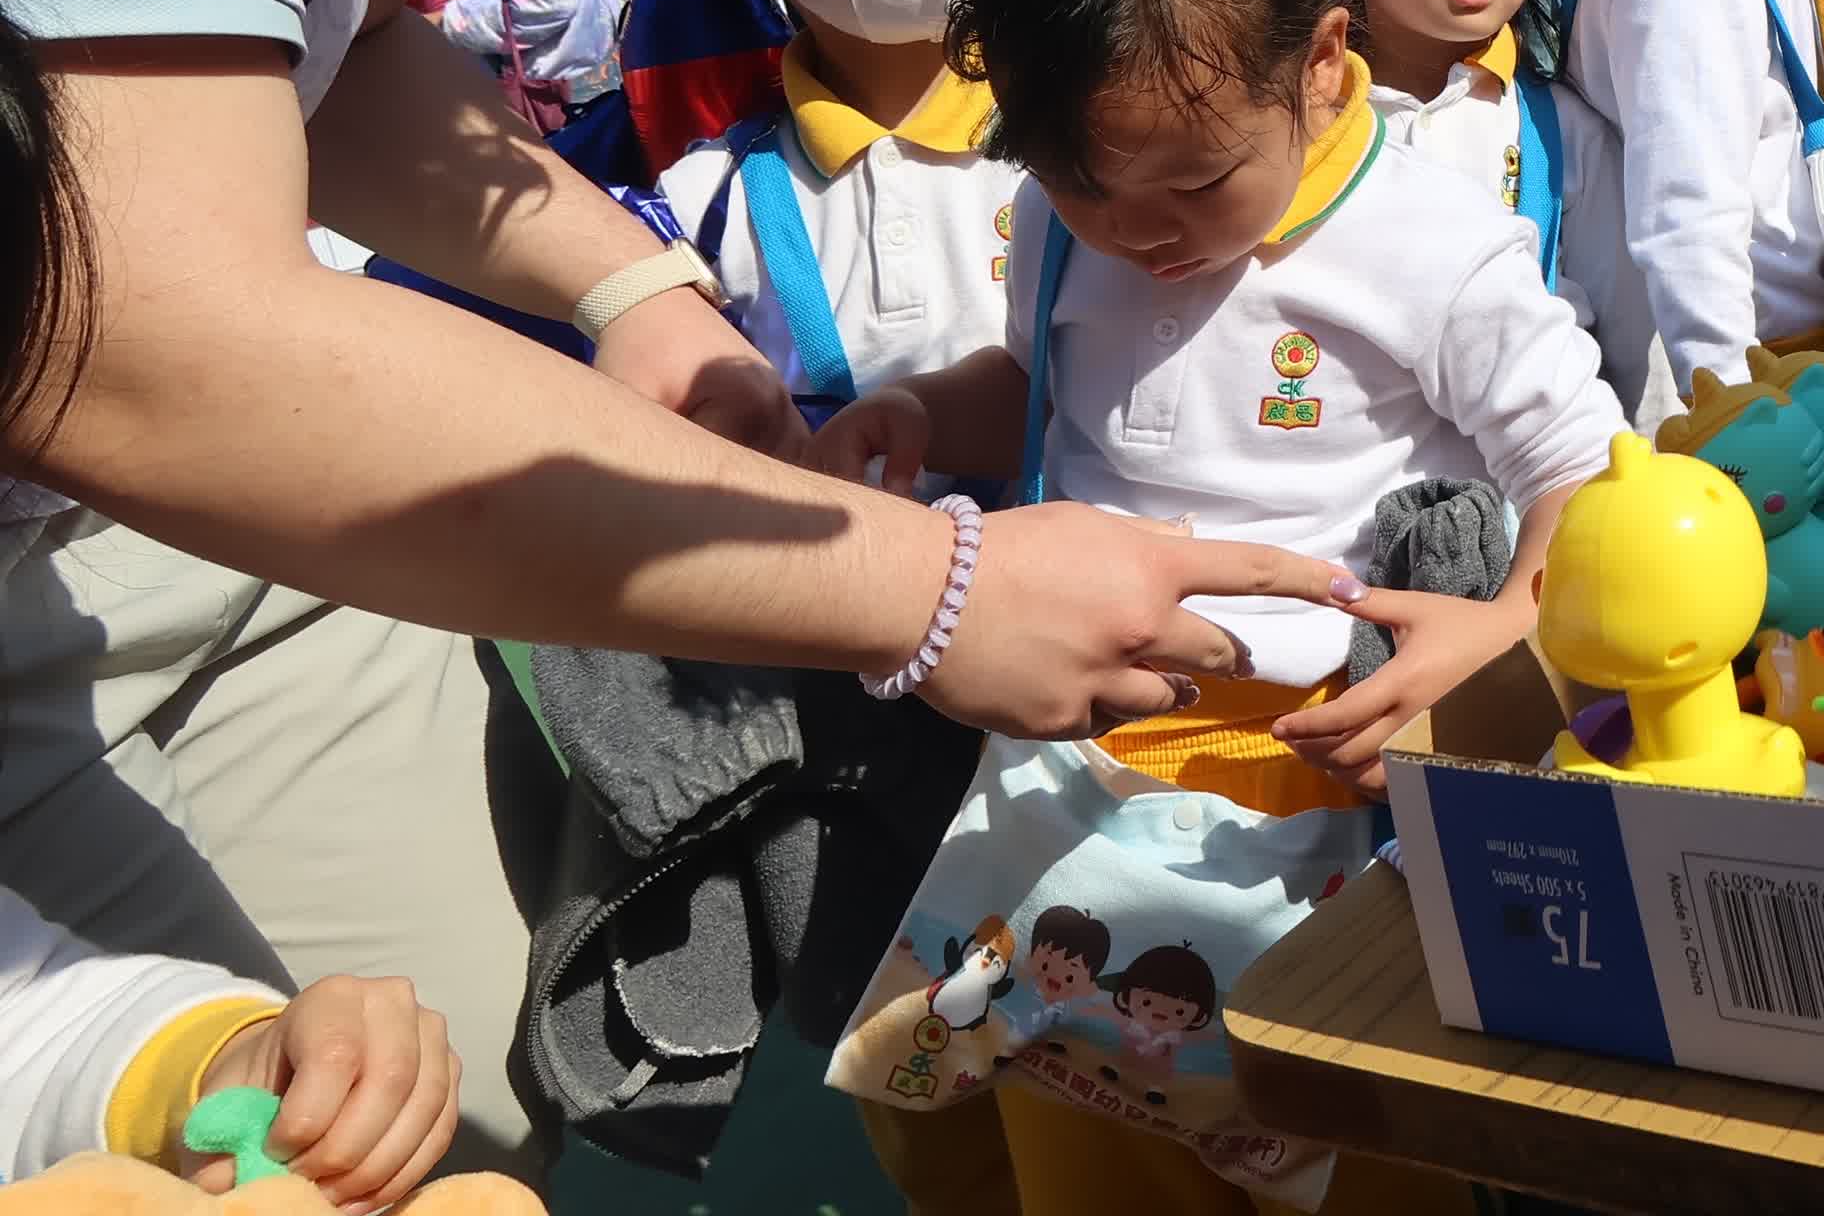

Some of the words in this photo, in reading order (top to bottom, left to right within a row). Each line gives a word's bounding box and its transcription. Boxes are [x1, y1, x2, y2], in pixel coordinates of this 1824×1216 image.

[1490, 868, 1534, 895] Sheets
[1536, 874, 1562, 896] 500
[1577, 880, 1587, 901] 5
[1666, 871, 1689, 920] Made
[1542, 905, 1601, 970] 75
[1680, 926, 1693, 942] in
[1685, 946, 1704, 997] China
